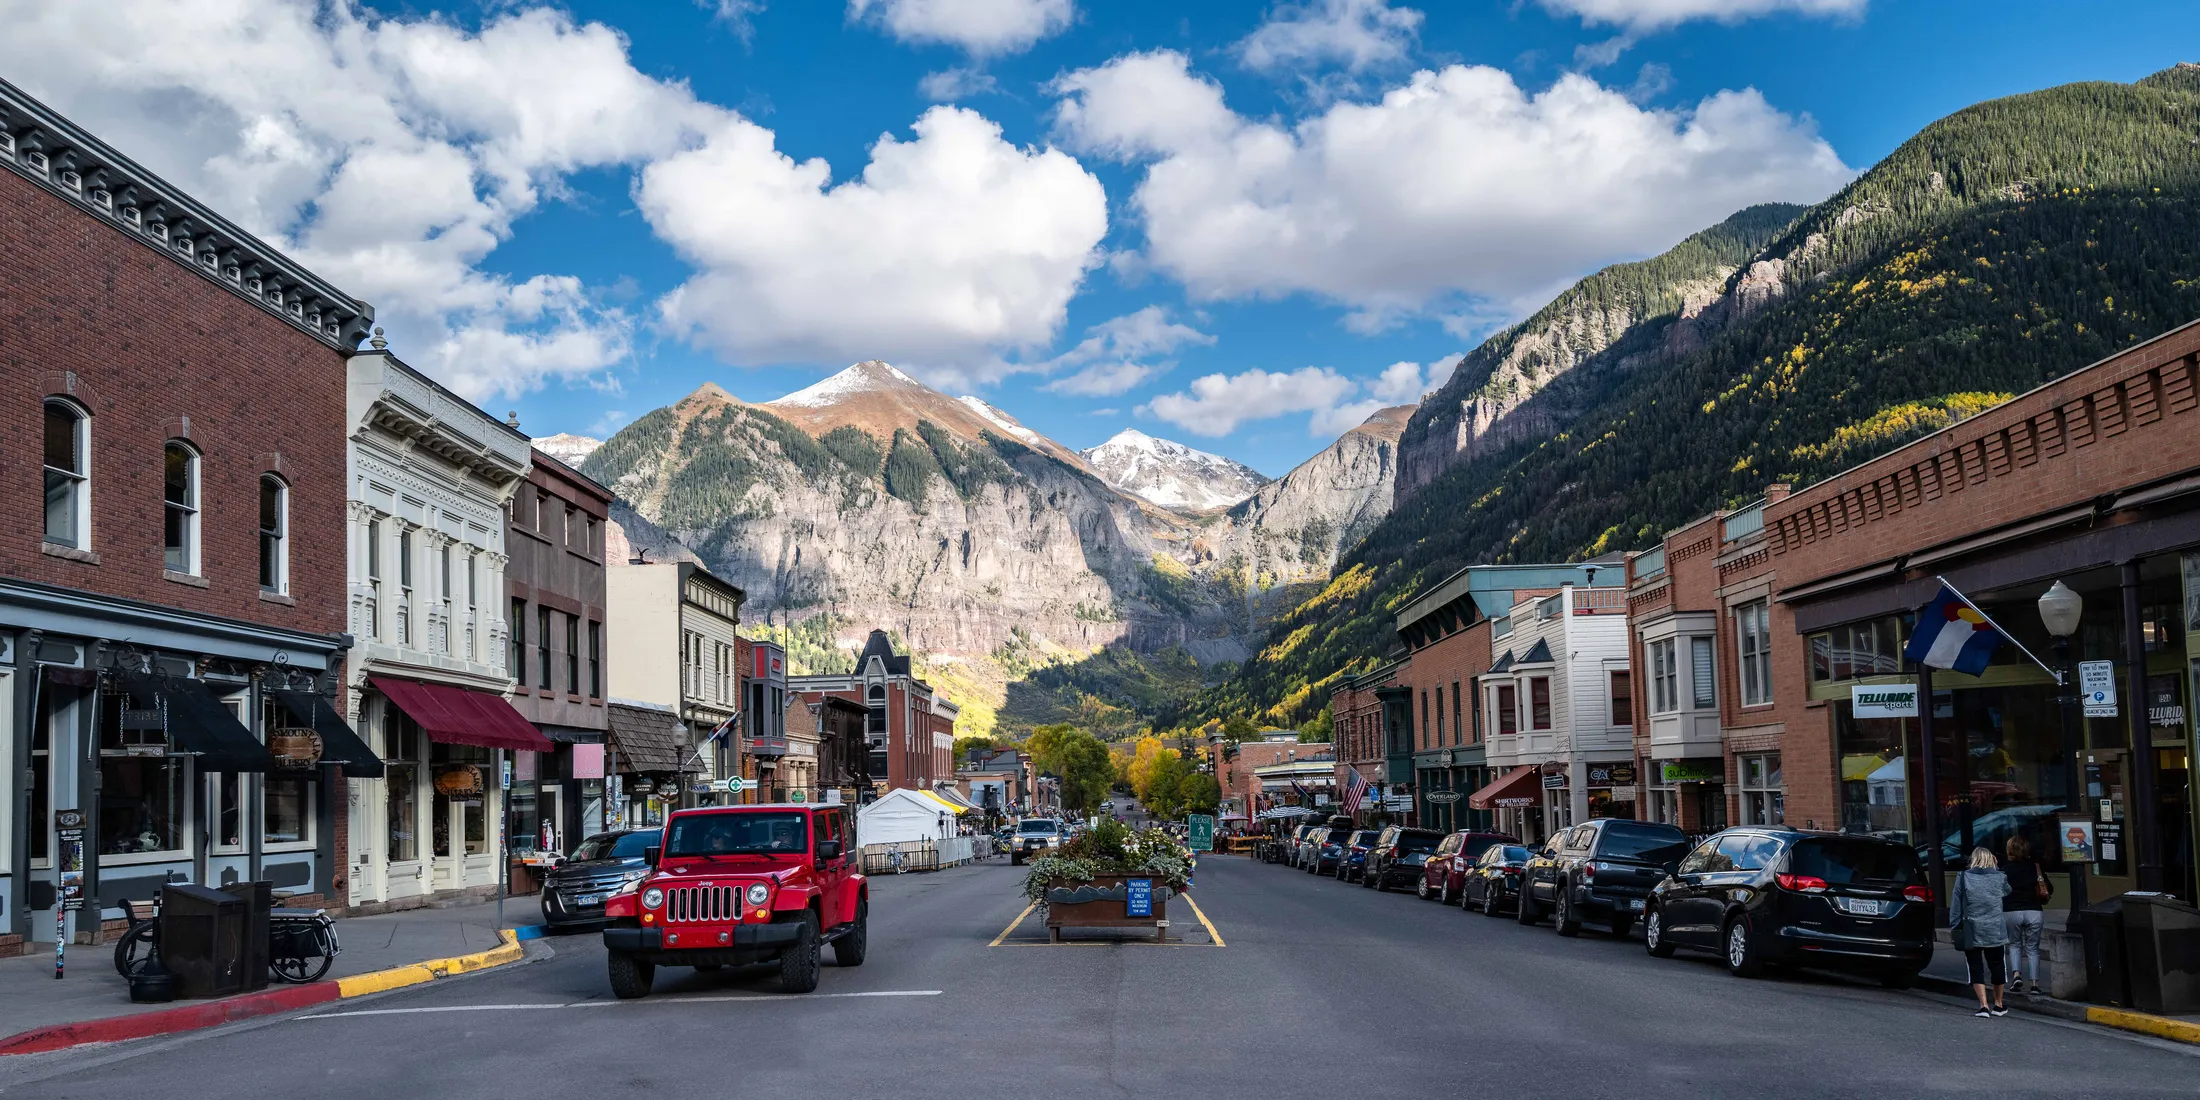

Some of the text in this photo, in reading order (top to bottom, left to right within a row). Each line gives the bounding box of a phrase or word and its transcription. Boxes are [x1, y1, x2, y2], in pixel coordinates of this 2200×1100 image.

[1858, 692, 1915, 703] TELLURIDE
[1885, 701, 1914, 710] sports
[126, 712, 158, 720] TRIBE
[280, 729, 320, 757] MOUNTAIN
[275, 758, 312, 768] ALLERY
[1668, 768, 1708, 777] sublime
[1851, 903, 1876, 913] 8UYY432
